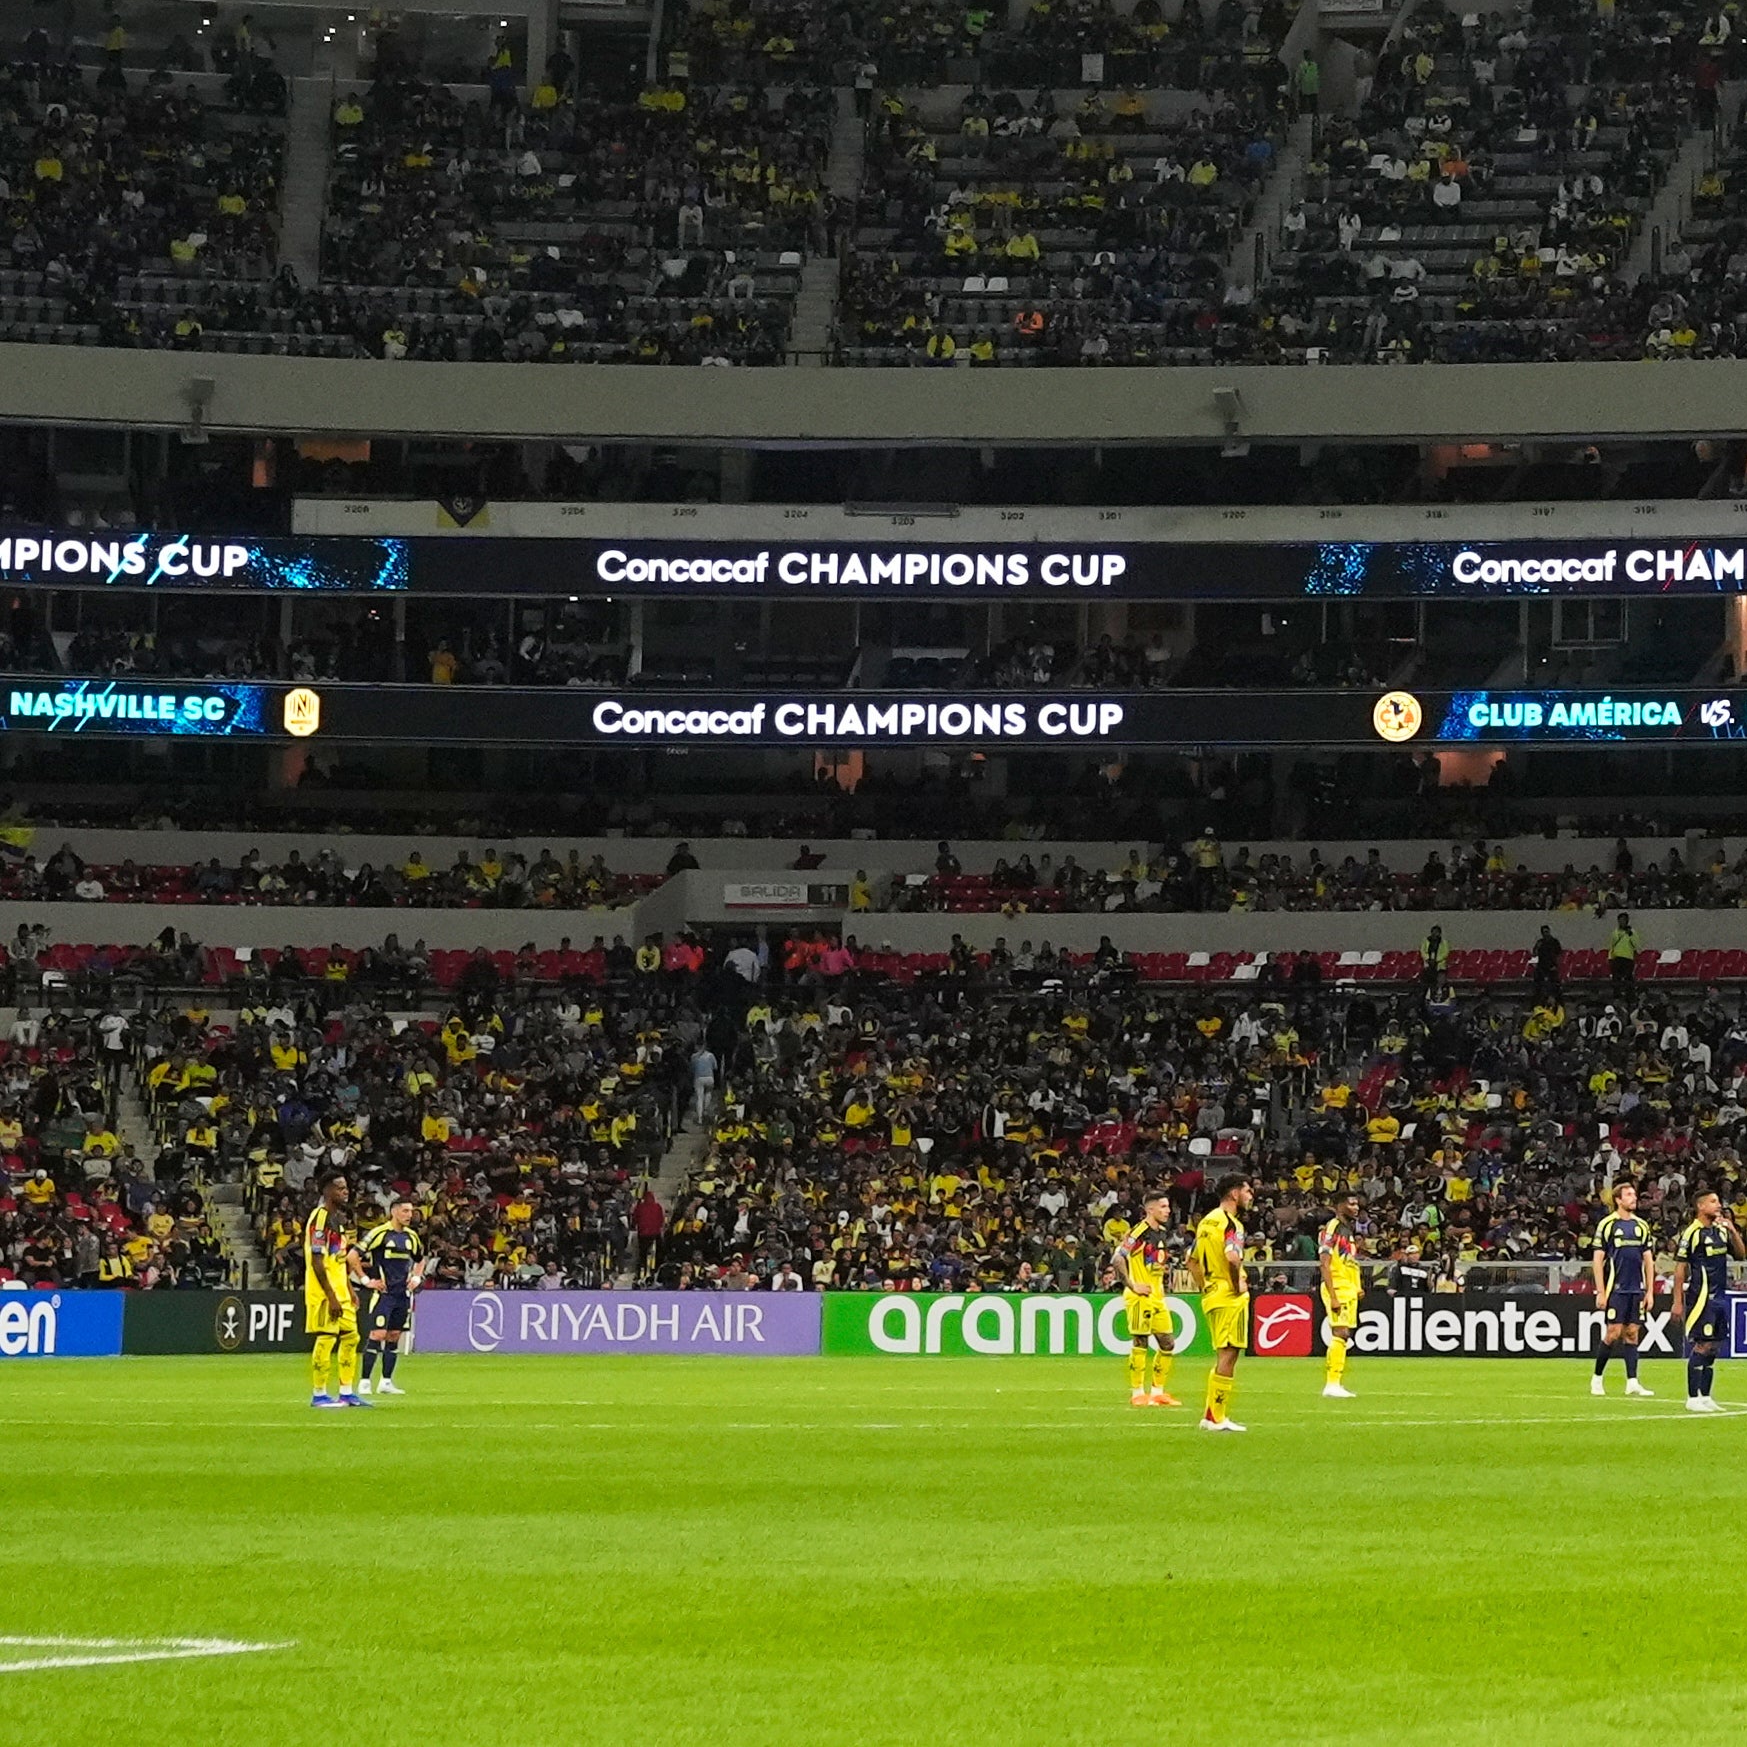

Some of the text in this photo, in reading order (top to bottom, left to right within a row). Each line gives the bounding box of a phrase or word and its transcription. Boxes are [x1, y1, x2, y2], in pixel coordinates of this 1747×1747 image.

[0, 537, 250, 577] PIONS CUP
[596, 549, 1127, 587] Concacaf CHAMPIONS CUP
[1452, 550, 1618, 585] Concacaf
[10, 692, 226, 721] NASHVILLE SC
[591, 701, 1125, 737] Concacaf CHAMPIONS CUP
[1468, 702, 1543, 728] CLUB
[1548, 693, 1683, 727] AMÉRICA
[739, 885, 837, 901] SALIDA 11
[248, 1303, 294, 1342] PIF
[520, 1302, 767, 1343] RIYADH AIR
